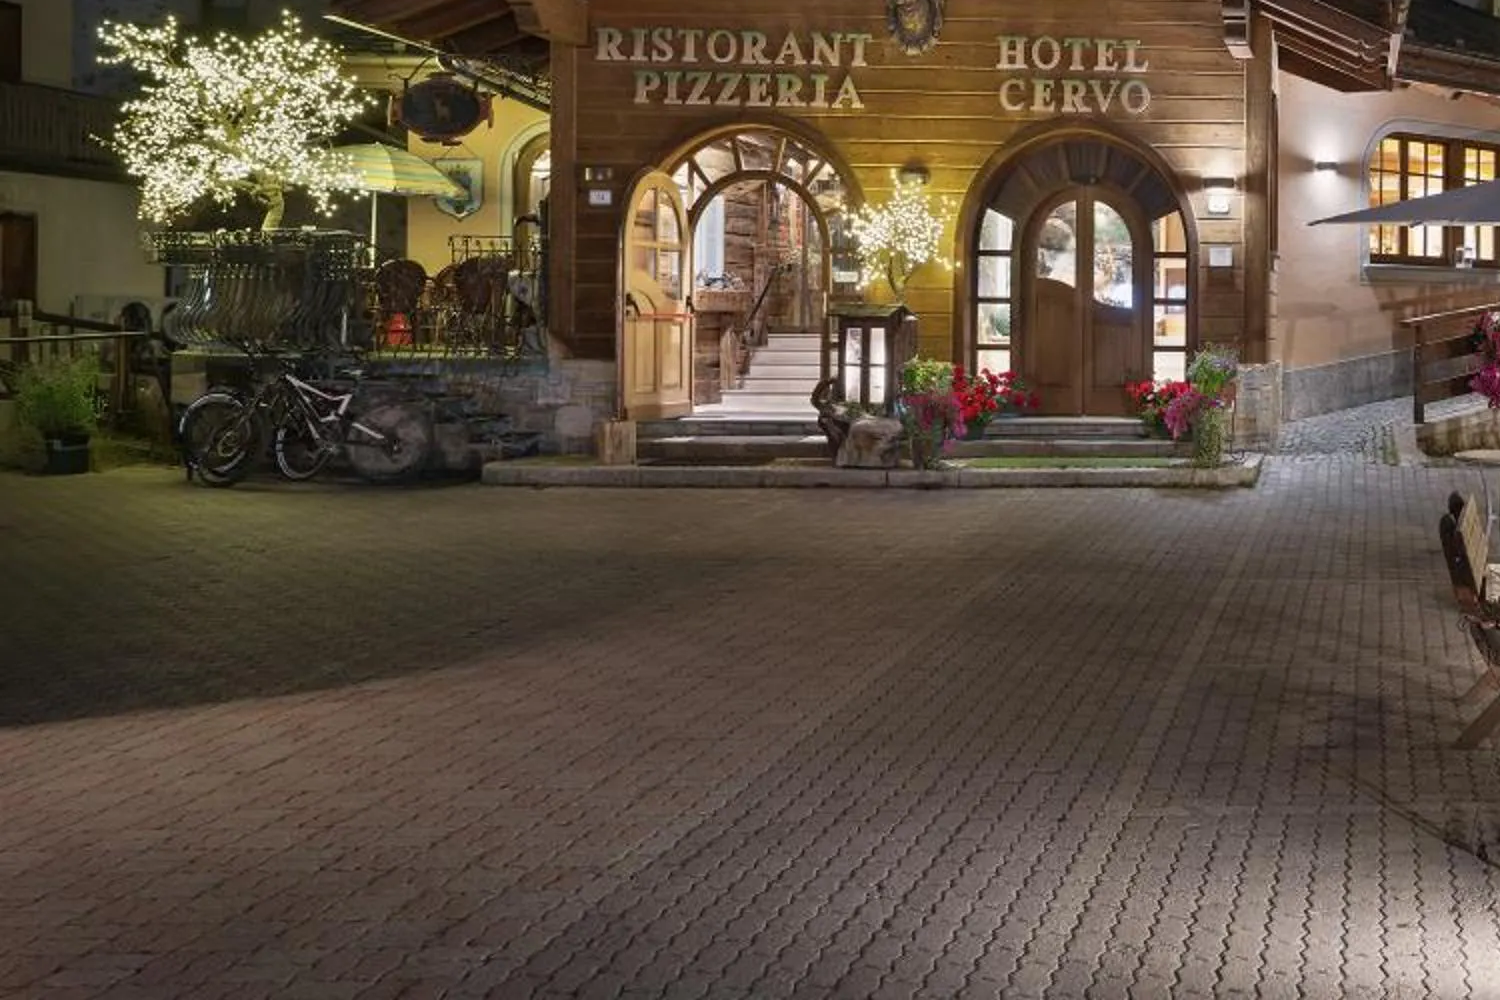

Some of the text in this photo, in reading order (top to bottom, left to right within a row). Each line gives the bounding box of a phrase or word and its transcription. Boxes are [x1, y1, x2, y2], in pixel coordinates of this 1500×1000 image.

[595, 27, 872, 67] RISTORANT
[996, 35, 1149, 72] HOTEL
[634, 70, 865, 108] PIZZERIA
[1001, 78, 1151, 114] CERVO
